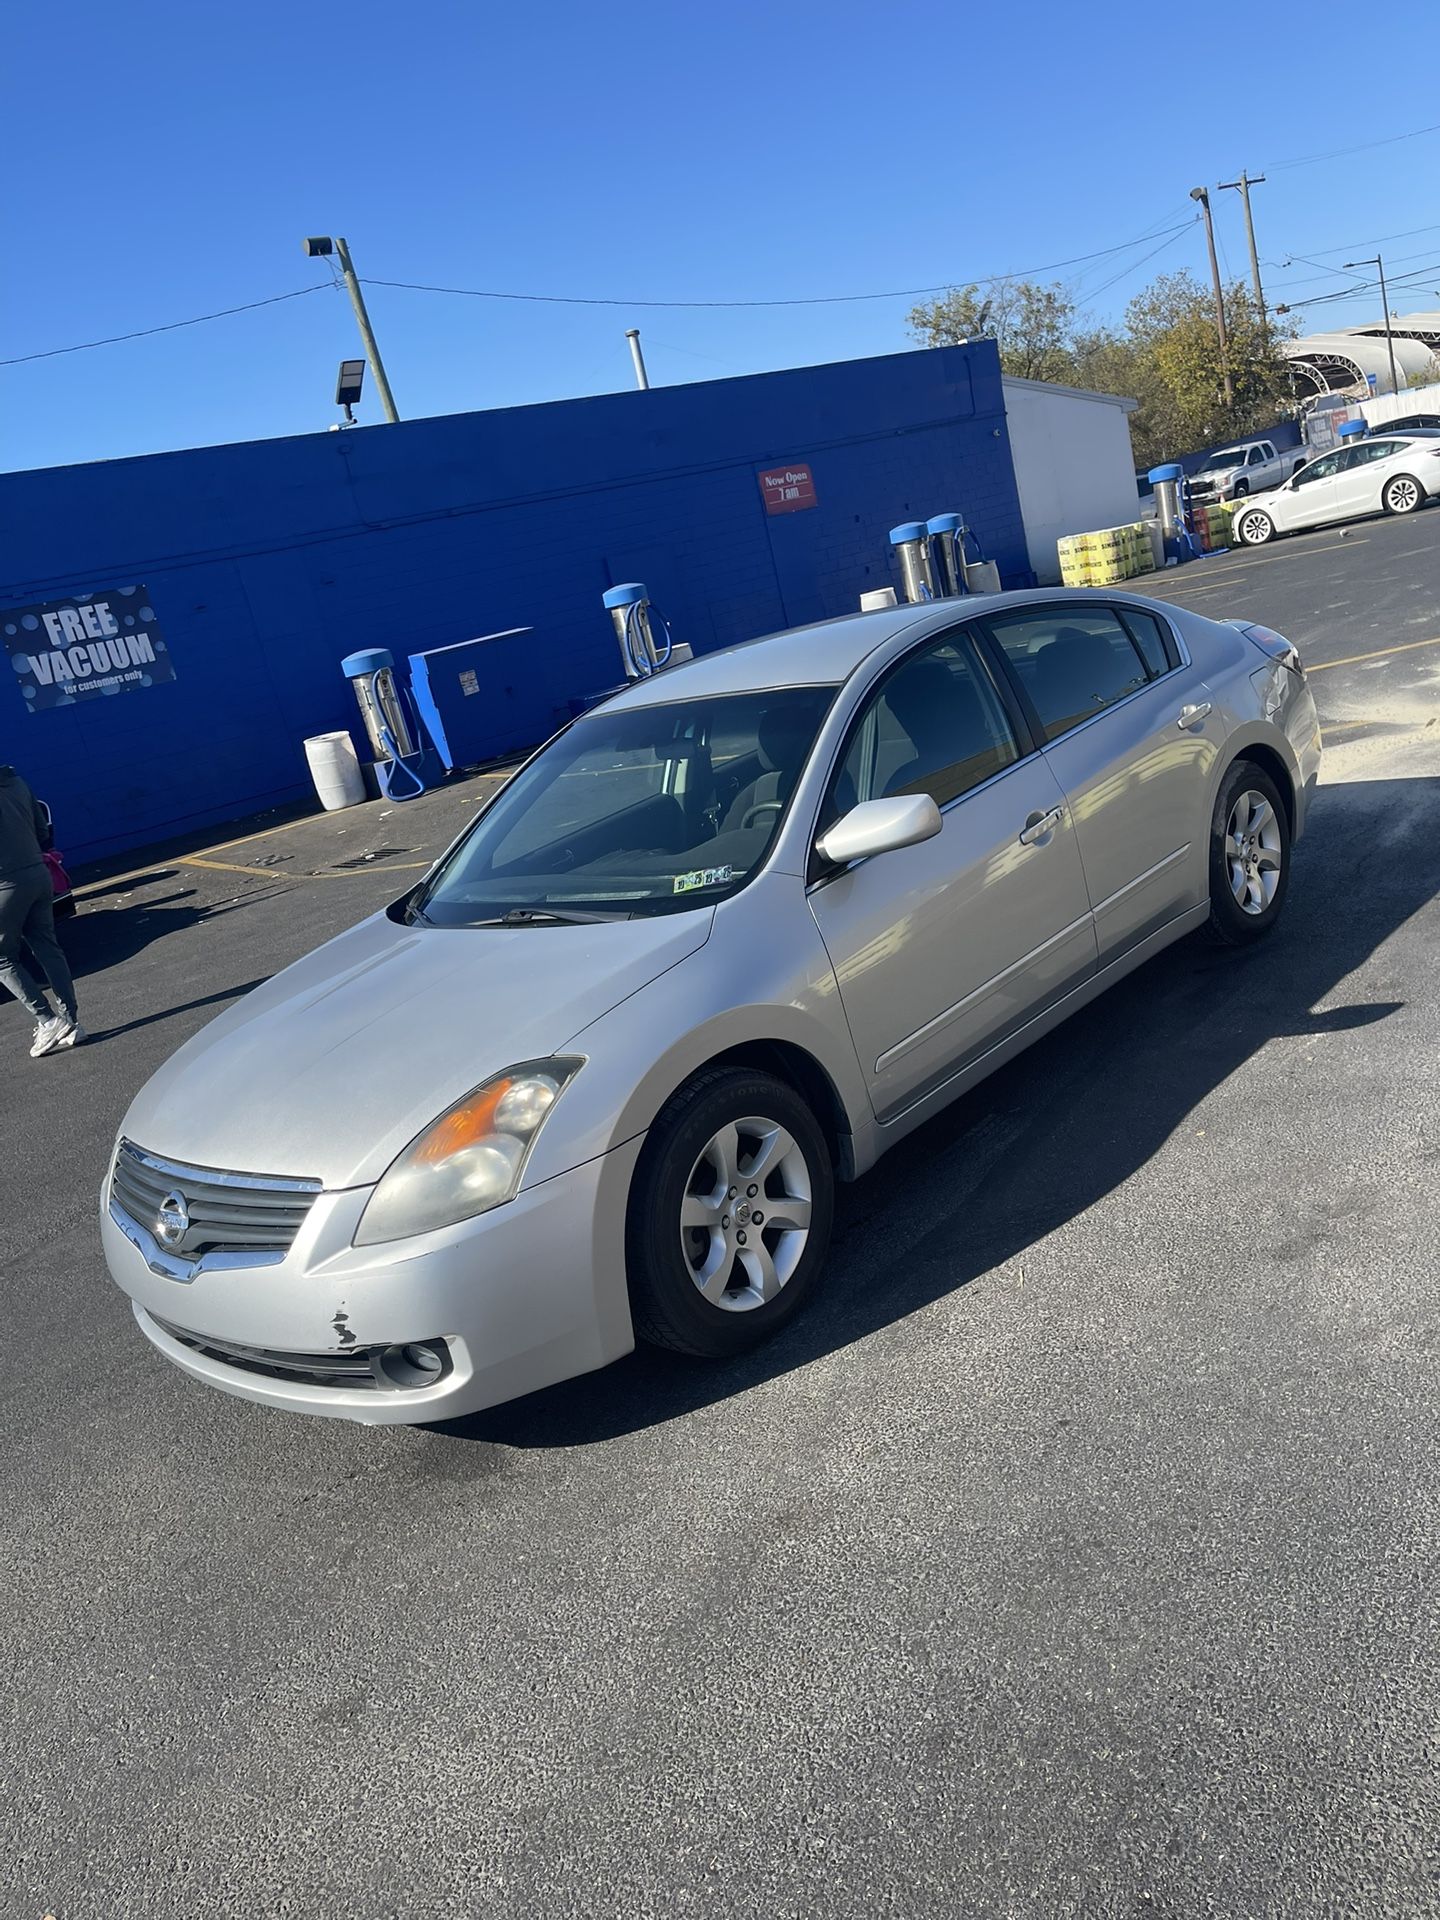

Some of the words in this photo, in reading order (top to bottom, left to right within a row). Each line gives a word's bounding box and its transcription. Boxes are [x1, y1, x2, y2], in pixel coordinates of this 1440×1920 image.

[765, 475, 784, 487] Now
[785, 471, 808, 484] Open
[778, 487, 784, 500] 7
[785, 487, 799, 499] am
[41, 602, 119, 646] FREE
[27, 632, 156, 686] VACUUM
[63, 684, 78, 695] for
[78, 675, 124, 692] customers
[124, 669, 143, 683] only
